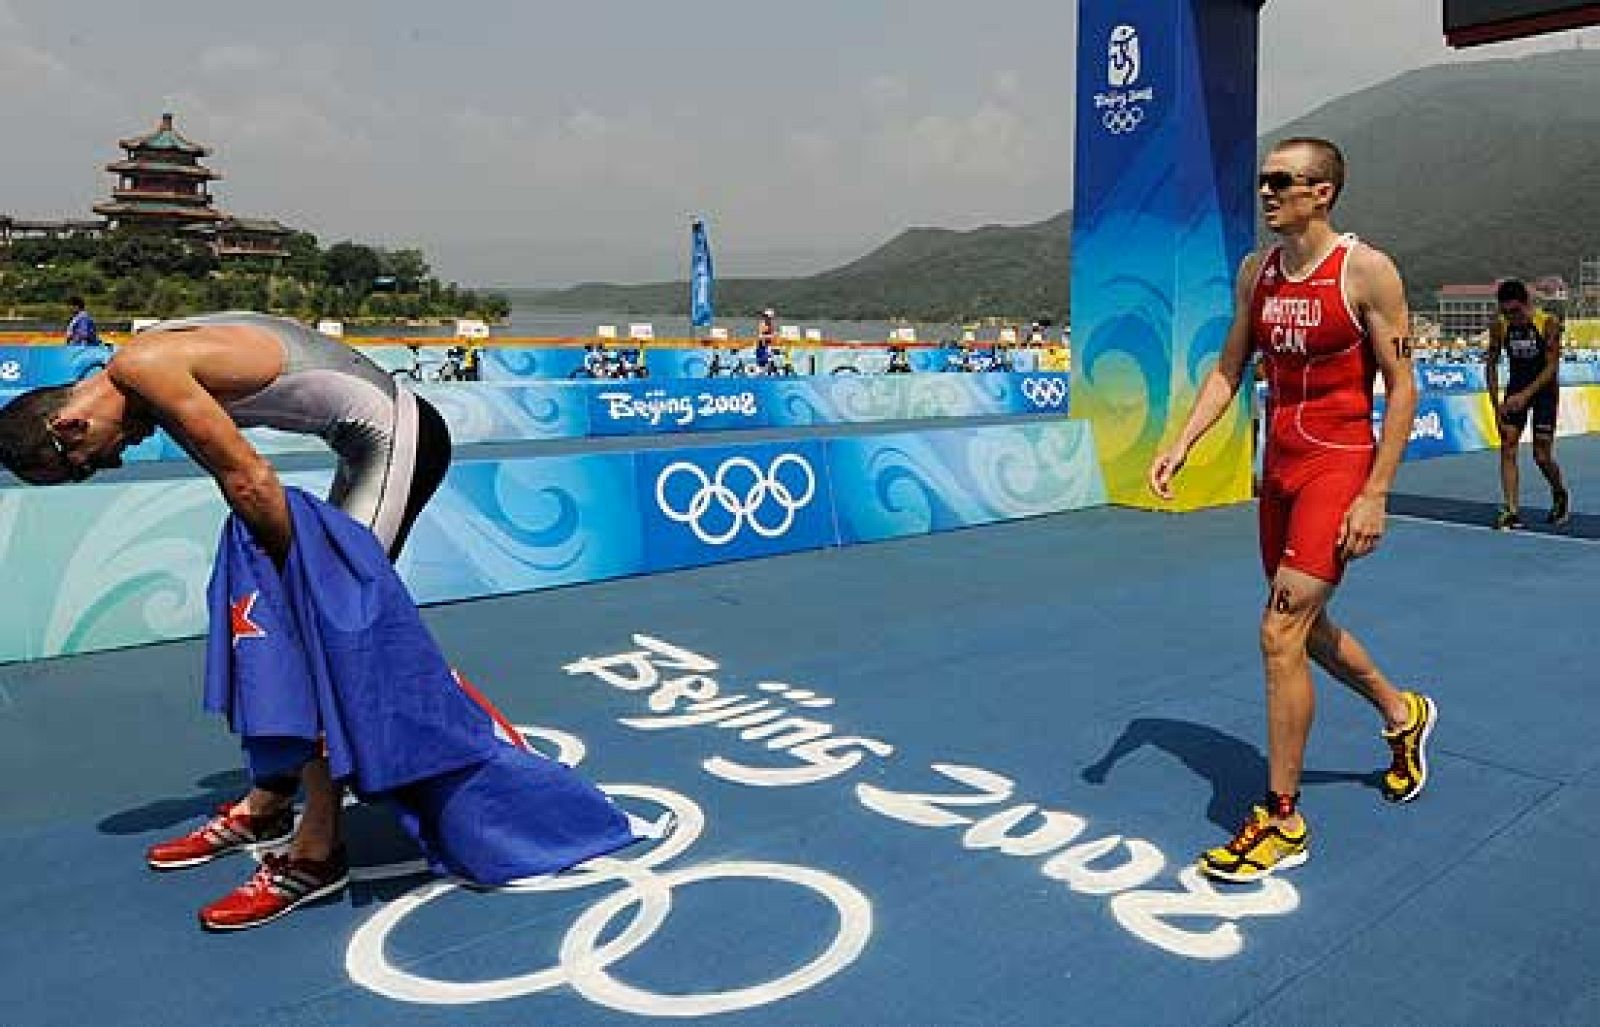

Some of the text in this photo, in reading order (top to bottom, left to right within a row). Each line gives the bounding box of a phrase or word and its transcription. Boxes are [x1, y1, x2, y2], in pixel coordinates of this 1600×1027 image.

[1262, 297, 1321, 326] WHITFIELD
[1271, 326, 1306, 354] CAN
[598, 389, 757, 426] Beijing 2008
[561, 633, 1301, 959] Beijing 2008
